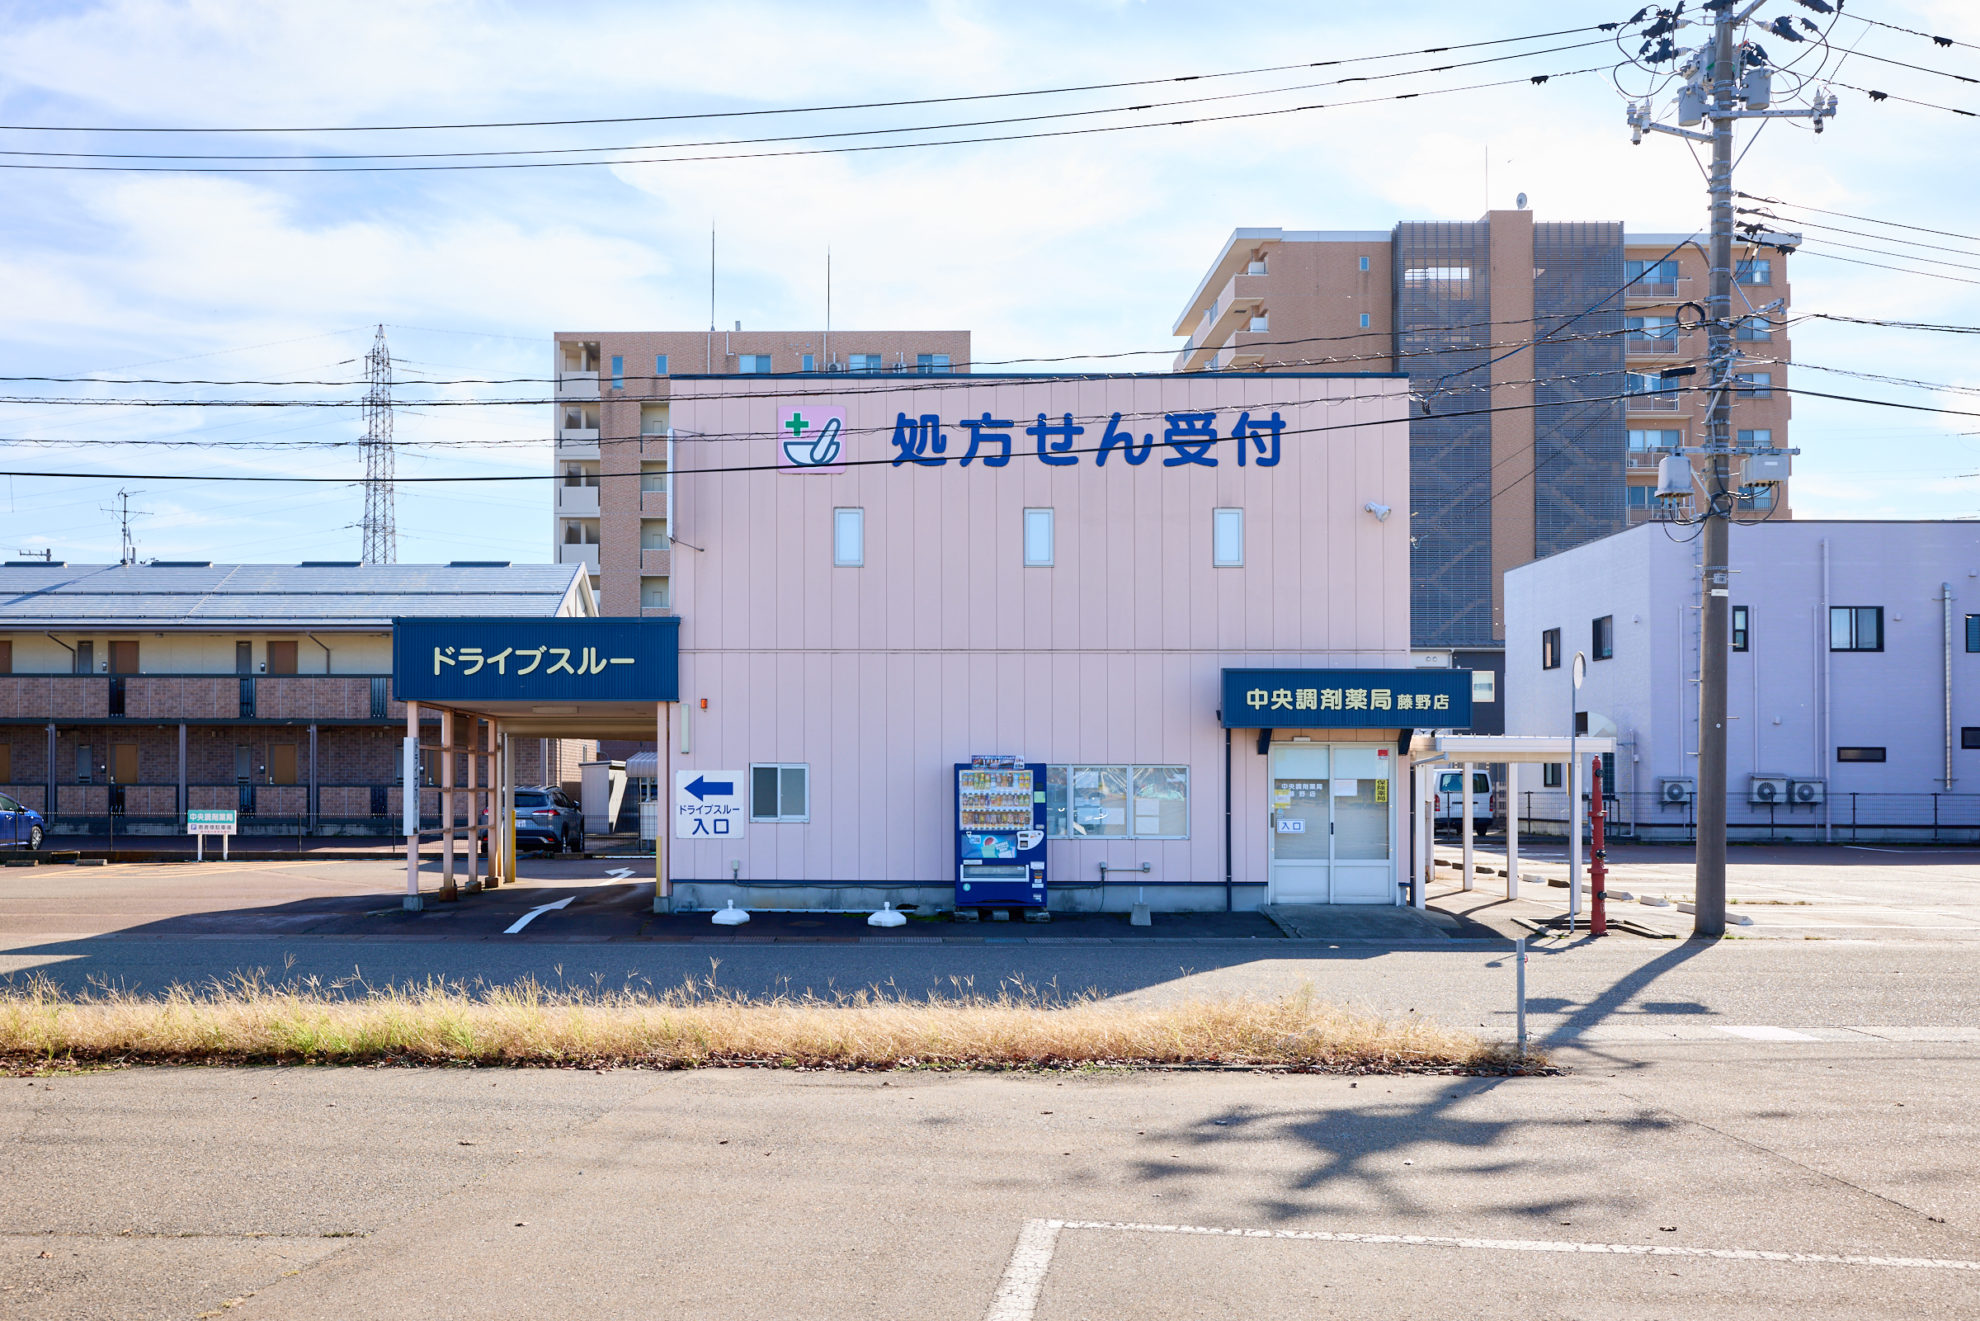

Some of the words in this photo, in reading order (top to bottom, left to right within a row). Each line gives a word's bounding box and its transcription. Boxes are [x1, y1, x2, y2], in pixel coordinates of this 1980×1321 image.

[891, 412, 1286, 467] 処方せん受付
[434, 646, 635, 675] ドライブスルー
[1246, 688, 1392, 711] 中央調剤薬局
[1397, 694, 1450, 711] 藤野店
[679, 804, 740, 815] ドライブスルー
[692, 818, 729, 835] 入口
[1281, 822, 1301, 830] 入口
